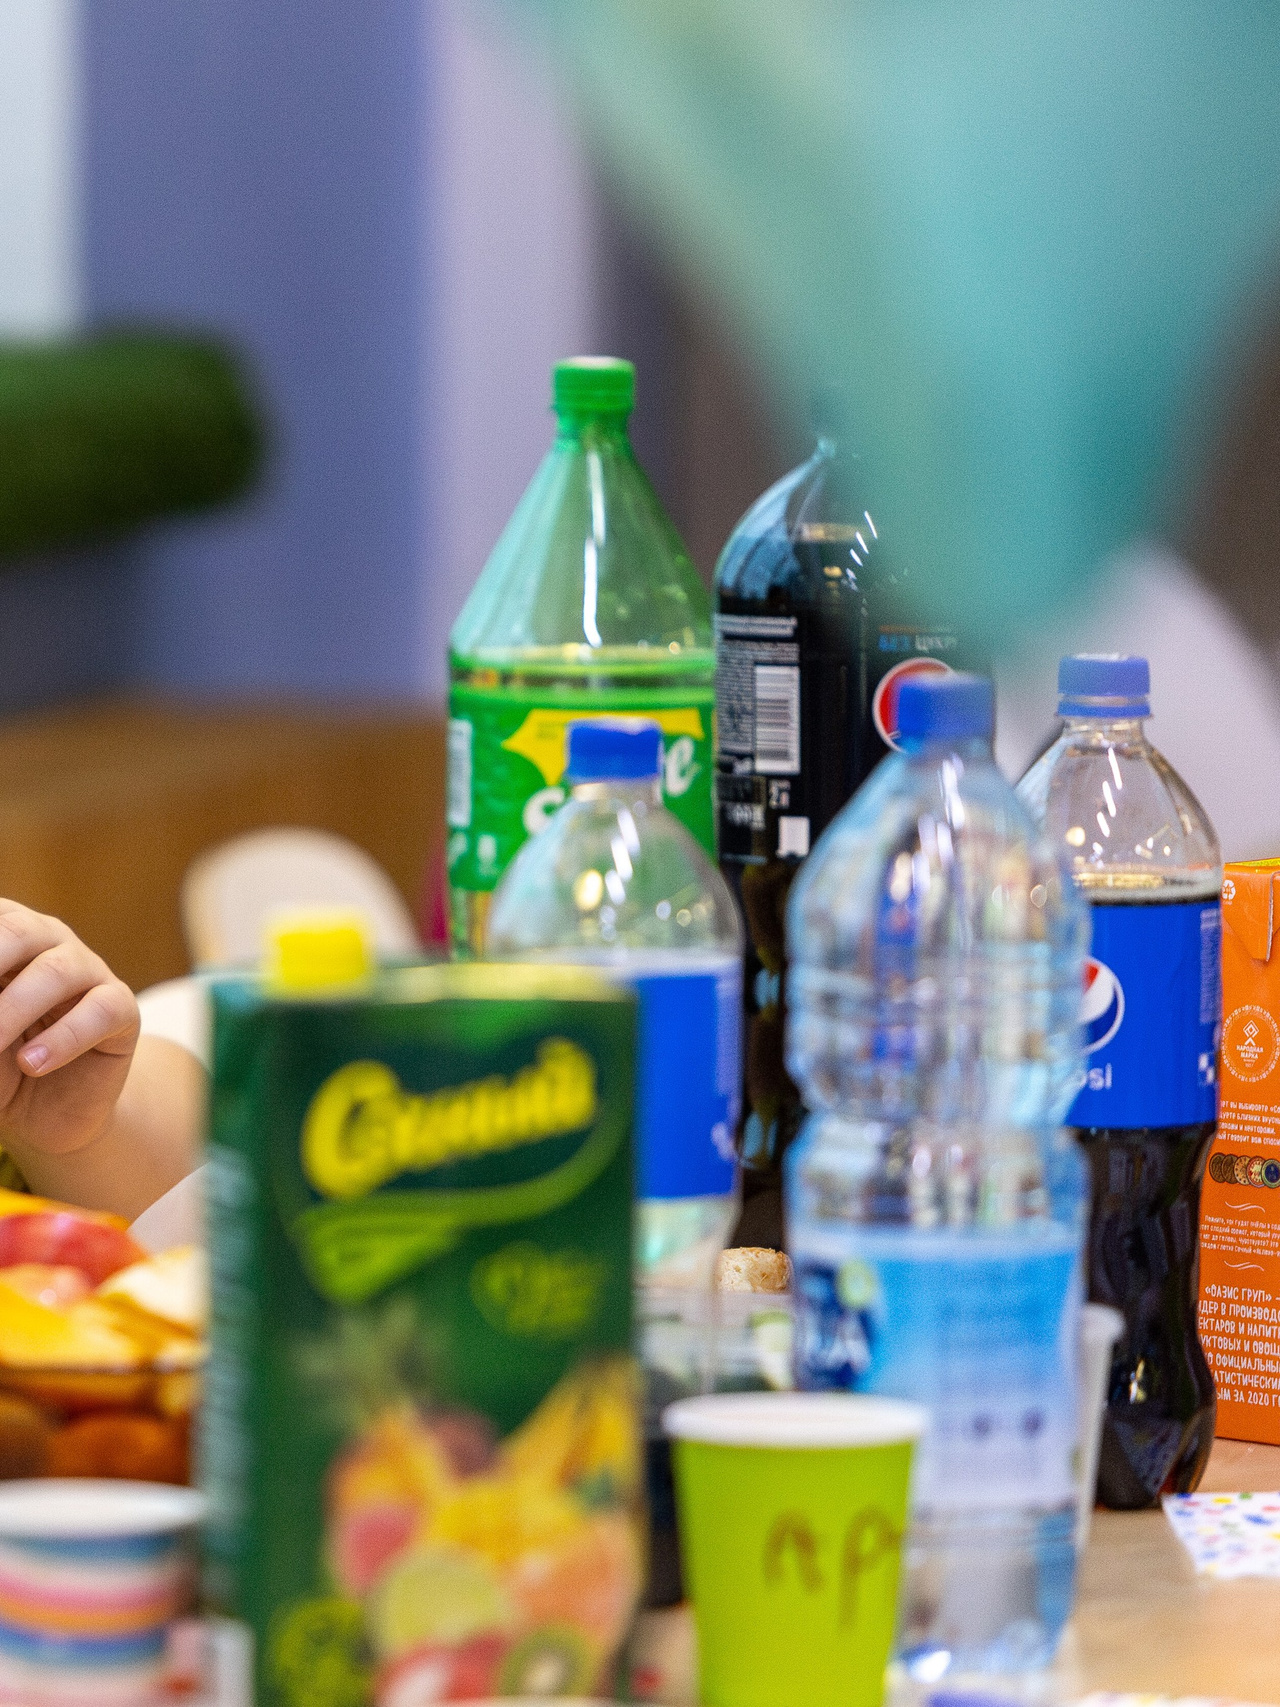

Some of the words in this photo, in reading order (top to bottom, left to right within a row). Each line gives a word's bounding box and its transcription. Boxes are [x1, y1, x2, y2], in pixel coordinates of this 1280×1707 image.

[1205, 1284, 1239, 1300] «ОАЗИС
[1241, 1288, 1272, 1303] ГРУП»
[1221, 1302, 1226, 1316] В
[1199, 1316, 1236, 1334] ЕКТАРОВ
[1238, 1322, 1245, 1335] И
[1200, 1333, 1241, 1351] УКТОВЫХ
[1244, 1340, 1250, 1353] И
[1205, 1351, 1213, 1365] О
[1216, 1353, 1280, 1374] ОФИЦИАЛЬНЫ
[1212, 1370, 1280, 1390] АТИСТИЧЕСКИ
[1216, 1388, 1231, 1401] ЫМ
[1234, 1389, 1245, 1403] ЗА
[1248, 1391, 1269, 1406] 2020
